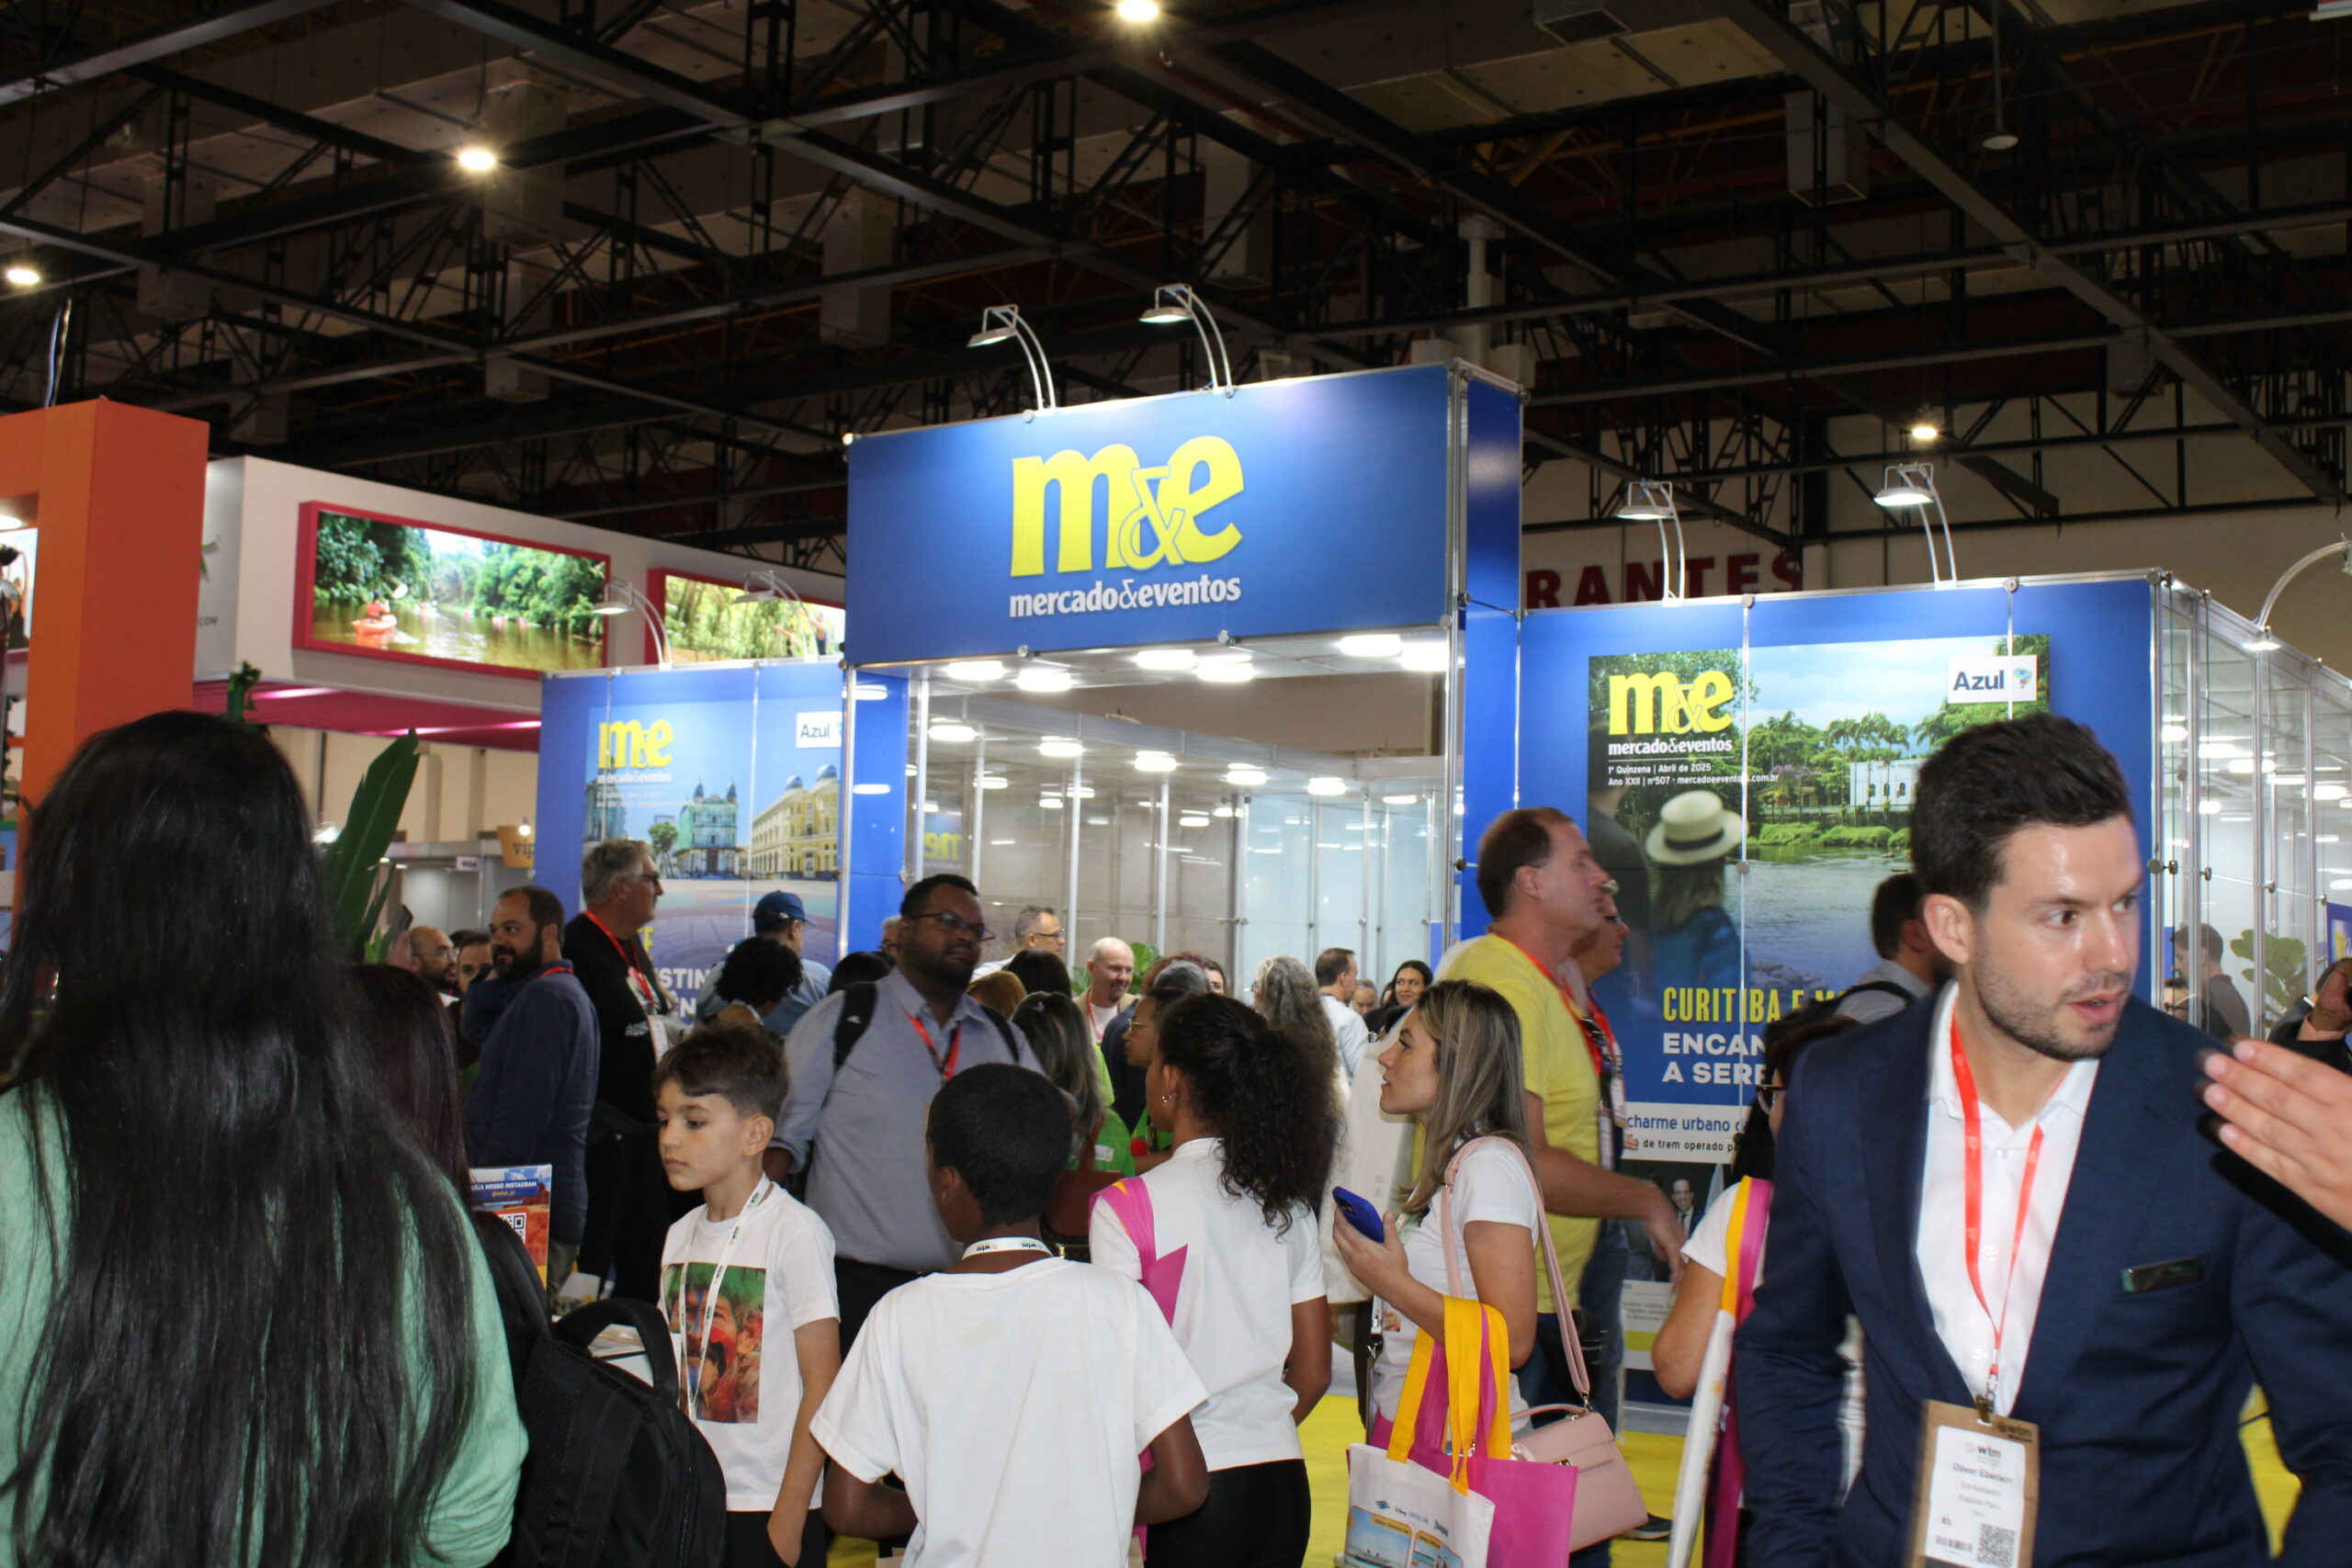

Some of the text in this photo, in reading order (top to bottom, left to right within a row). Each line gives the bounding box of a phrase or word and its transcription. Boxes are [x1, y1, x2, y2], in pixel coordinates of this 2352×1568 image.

[1011, 435, 1244, 577] m&e
[1009, 574, 1242, 617] mercado&eventos
[1952, 669, 2005, 692] Azul
[1609, 671, 1735, 735] m&e
[799, 723, 831, 739] Azul
[1609, 737, 1733, 756] mercado&eventos
[1616, 764, 1651, 774] Quinzena
[1658, 763, 1677, 773] Abril
[1679, 763, 1689, 773] de
[1690, 763, 1712, 773] 2025
[1608, 777, 1623, 786] Ano
[1624, 776, 1641, 786] XXII
[653, 967, 710, 989] STIN
[1663, 987, 1781, 1022] CURITIBA
[1662, 1061, 1684, 1083] A
[1627, 1114, 1678, 1130] charme
[1682, 1116, 1730, 1132] urbano
[1643, 1138, 1655, 1147] de
[1658, 1140, 1680, 1149] trem
[1684, 1141, 1724, 1152] operado
[504, 1180, 537, 1190] INSTAGRAM
[1978, 1446, 2001, 1459] wtm
